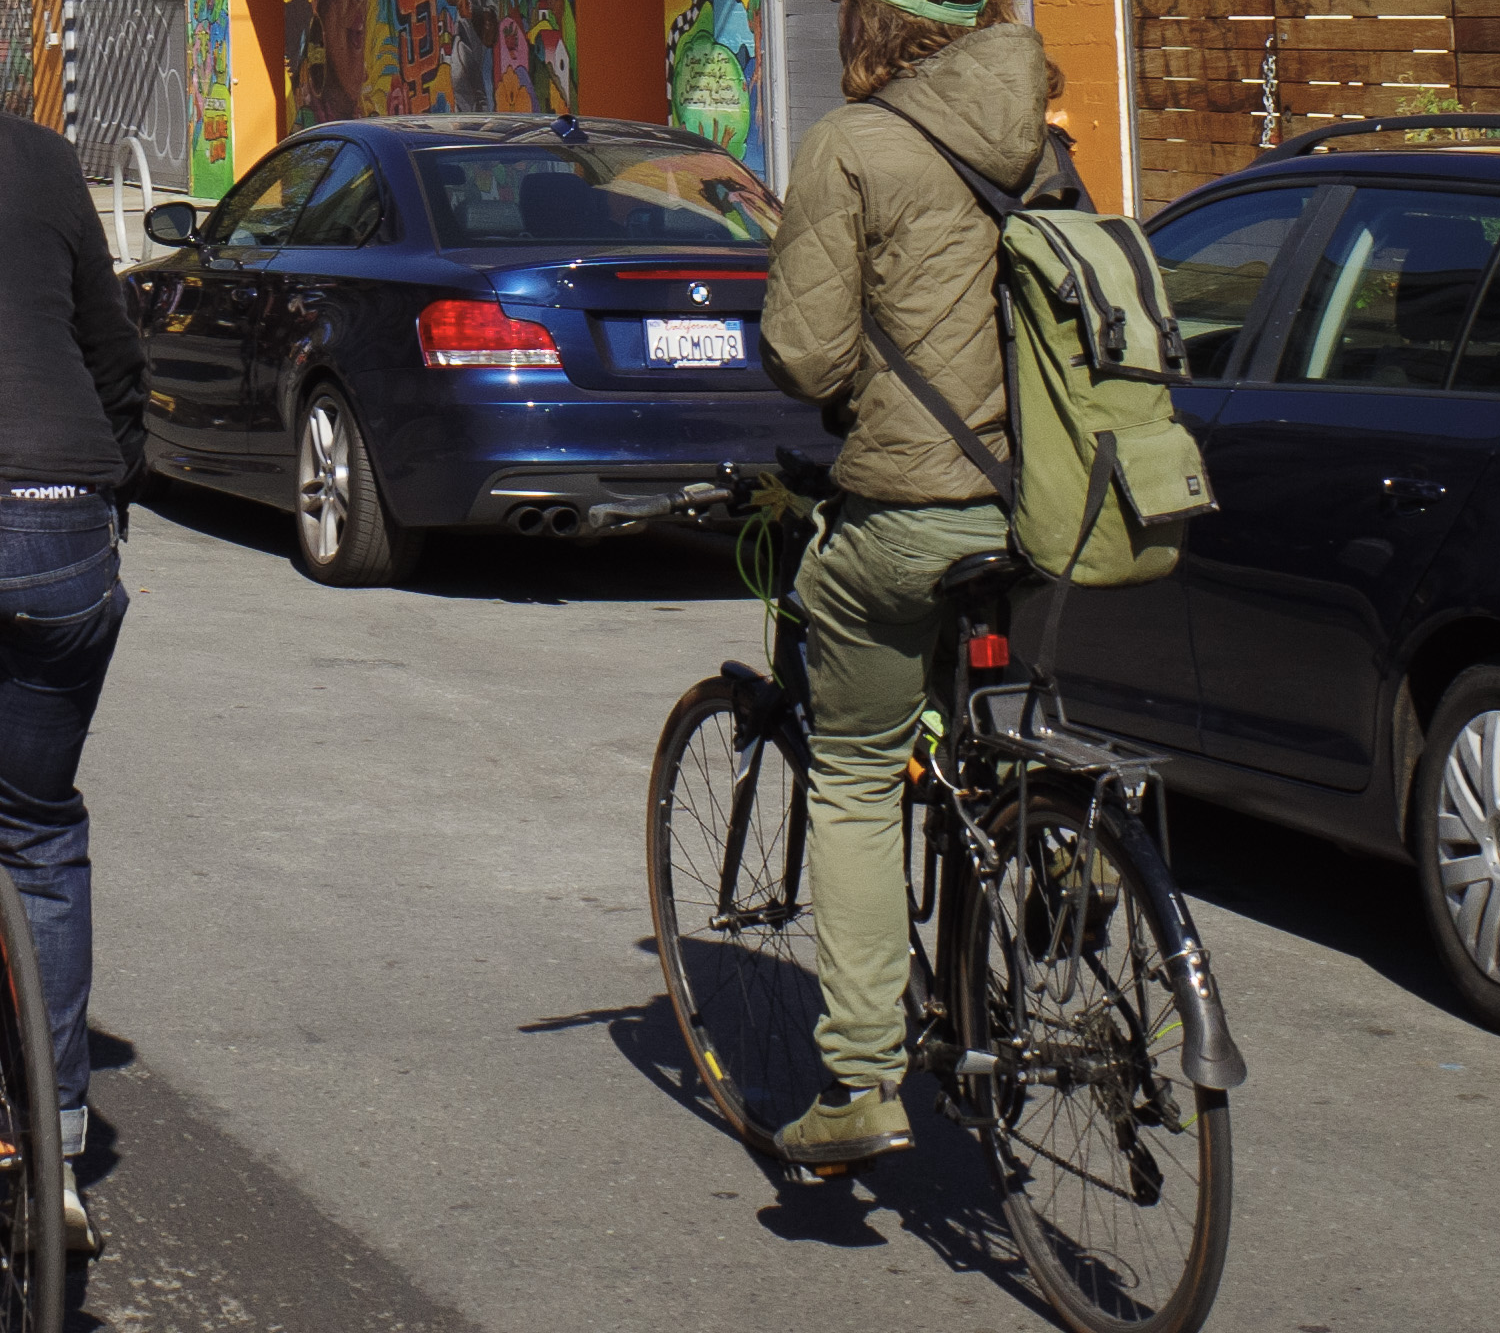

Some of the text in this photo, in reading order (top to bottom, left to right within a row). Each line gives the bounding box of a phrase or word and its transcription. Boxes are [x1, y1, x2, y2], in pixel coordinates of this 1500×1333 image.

[665, 321, 725, 334] California
[654, 335, 738, 359] 6LCM078
[10, 485, 76, 499] TOMMY
